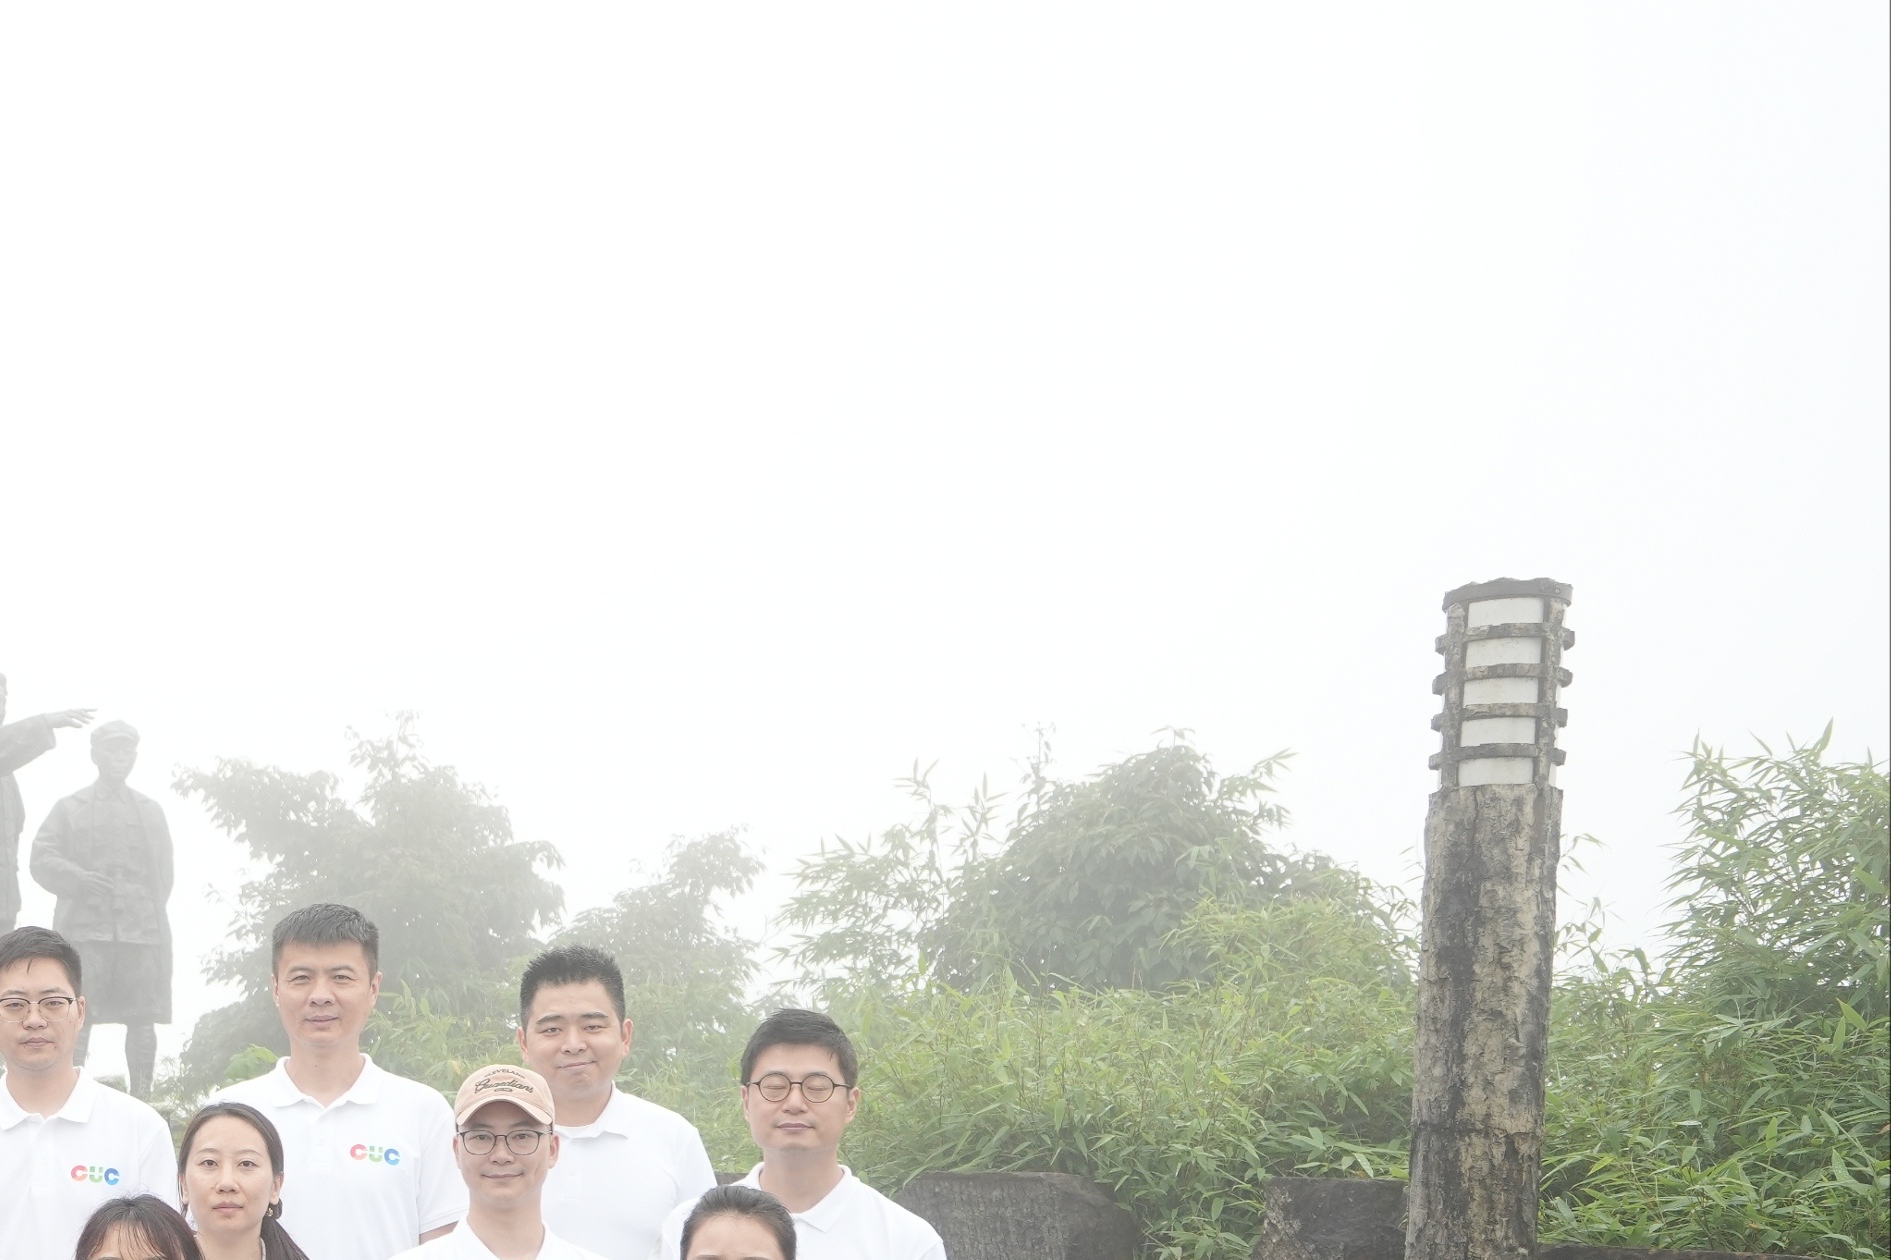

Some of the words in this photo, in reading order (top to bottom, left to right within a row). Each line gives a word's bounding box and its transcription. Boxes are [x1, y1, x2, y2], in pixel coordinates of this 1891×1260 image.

[474, 1078, 534, 1094] Guardians
[350, 1143, 401, 1166] CUC
[70, 1164, 120, 1186] CUC
